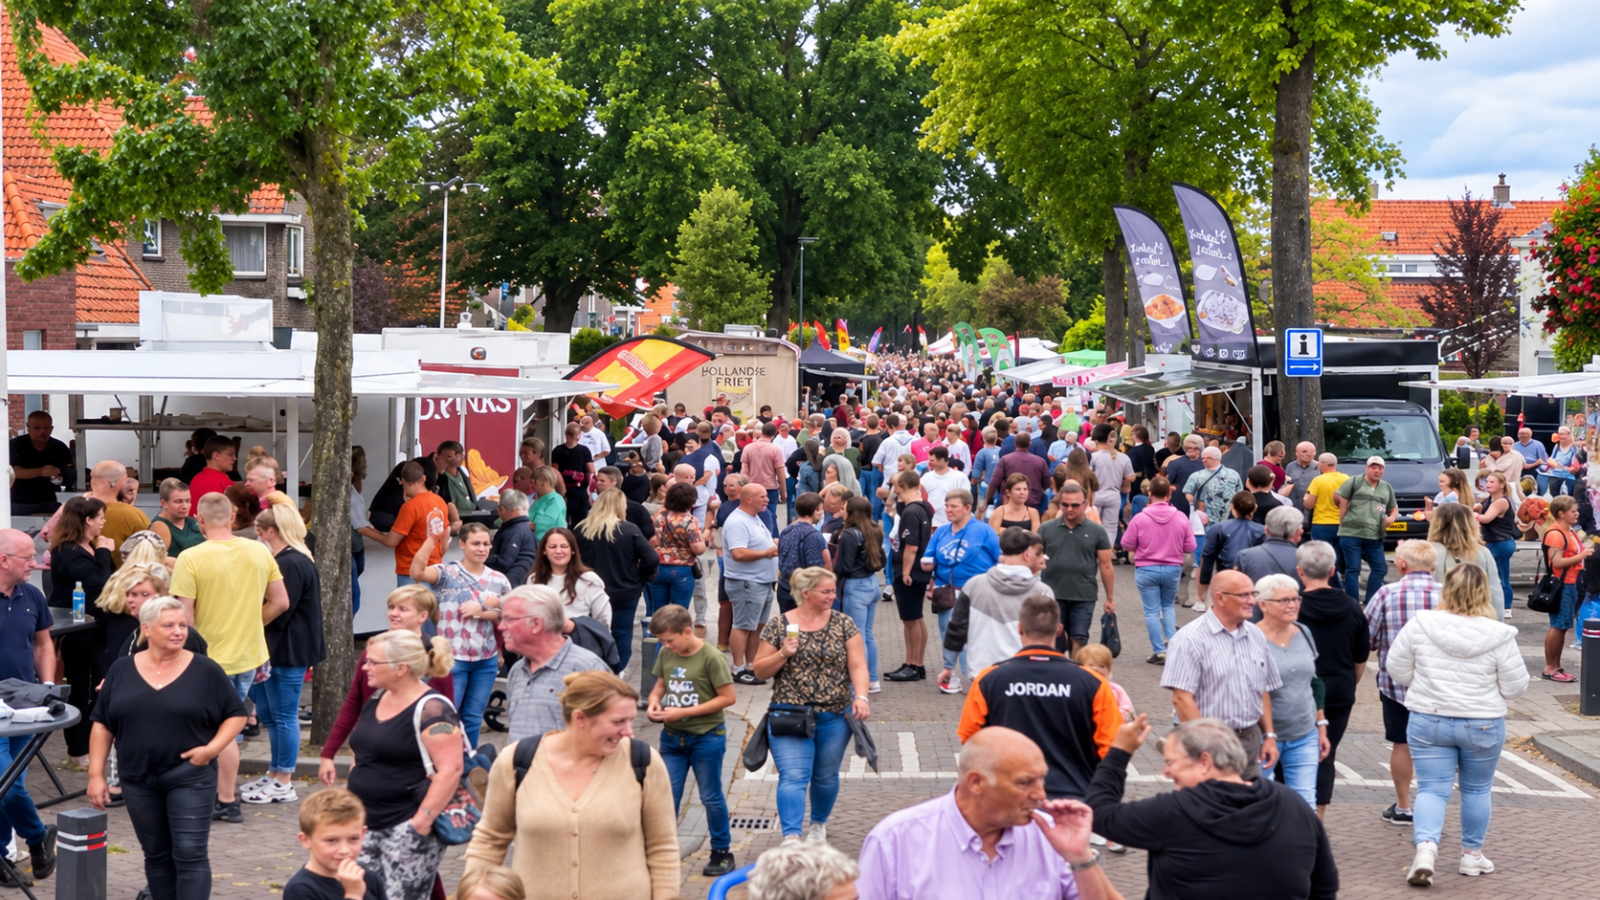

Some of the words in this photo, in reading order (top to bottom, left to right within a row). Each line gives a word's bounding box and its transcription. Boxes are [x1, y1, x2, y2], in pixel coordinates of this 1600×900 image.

[701, 366, 766, 377] HOLLANDSE
[716, 377, 753, 387] FRIET
[1004, 682, 1071, 698] JORDAN
